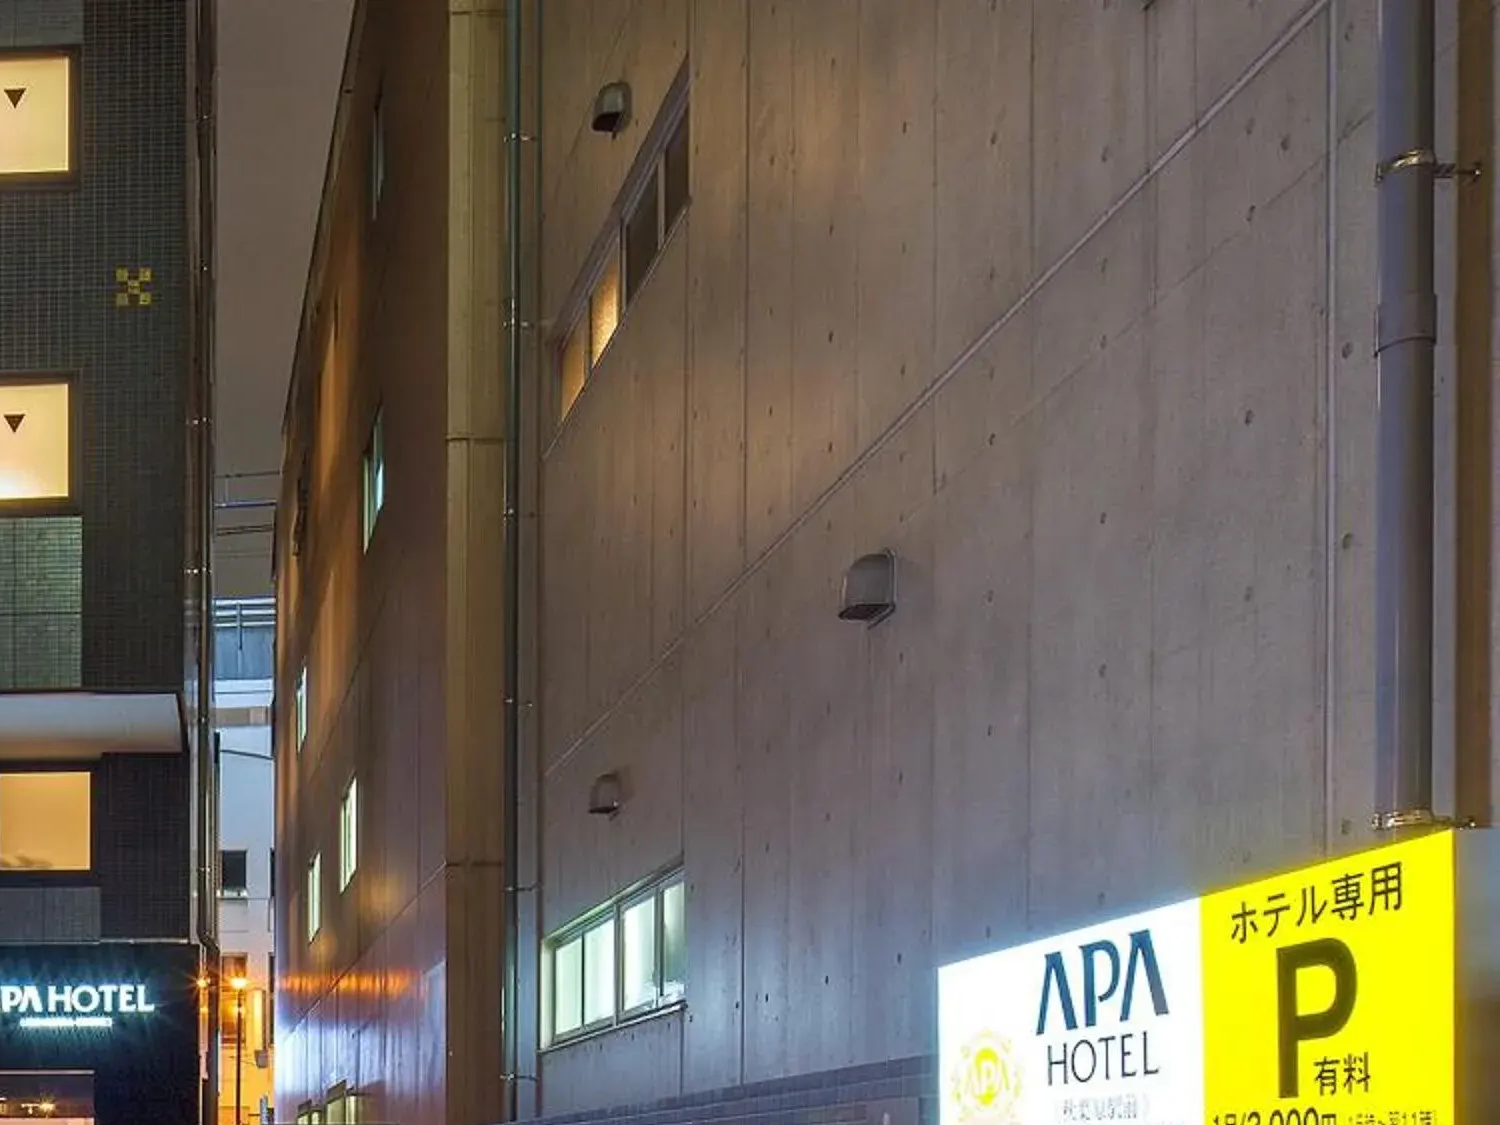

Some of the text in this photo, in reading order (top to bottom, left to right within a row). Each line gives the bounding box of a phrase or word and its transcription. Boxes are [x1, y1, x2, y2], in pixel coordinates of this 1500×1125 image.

[1231, 862, 1403, 944] ホテル専用
[47, 984, 155, 1013] HOTEL
[1036, 929, 1170, 1035] APA
[1276, 937, 1358, 1099] P
[1047, 1030, 1160, 1086] HOTEL
[1313, 1052, 1371, 1096] 有料
